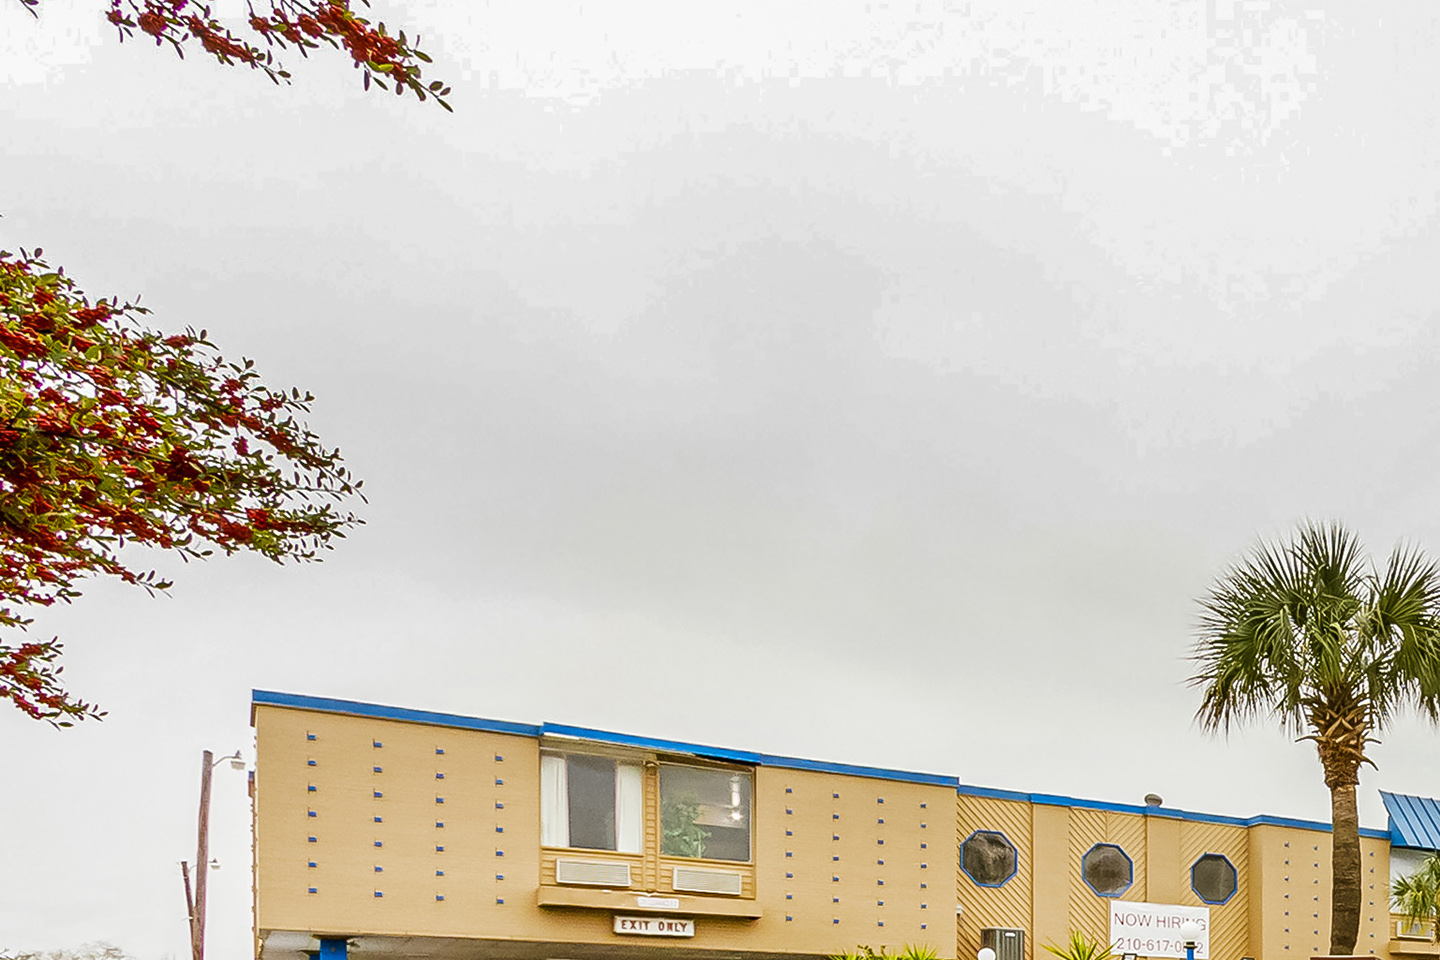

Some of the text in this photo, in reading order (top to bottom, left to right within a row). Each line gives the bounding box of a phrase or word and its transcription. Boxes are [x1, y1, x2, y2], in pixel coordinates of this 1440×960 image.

[621, 919, 687, 932] EXIT ONLY
[1114, 912, 1206, 931] NOW HIRIG
[1117, 937, 1203, 954] 210-617-02
